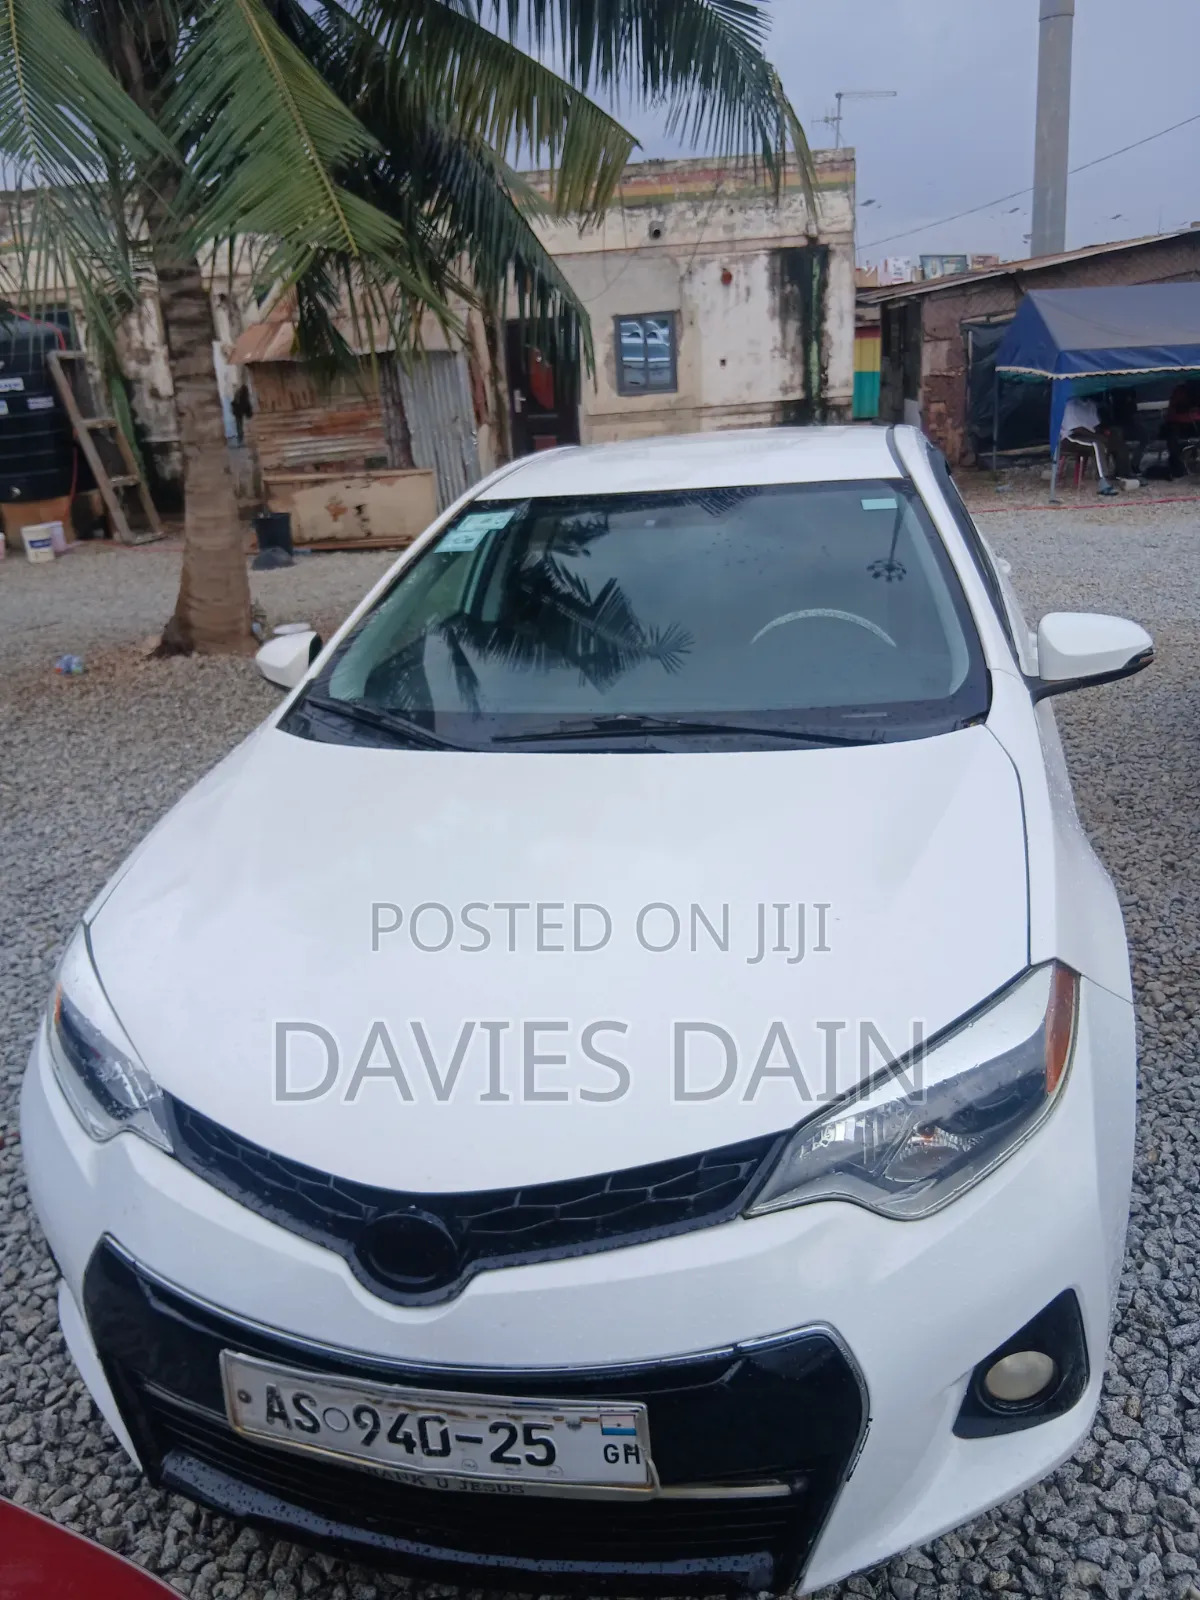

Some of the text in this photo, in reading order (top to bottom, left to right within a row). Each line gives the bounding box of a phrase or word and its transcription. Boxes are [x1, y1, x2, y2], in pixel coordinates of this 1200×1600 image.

[264, 1383, 321, 1434] AS
[603, 1443, 641, 1465] GH
[459, 1480, 525, 1494] JESUS
